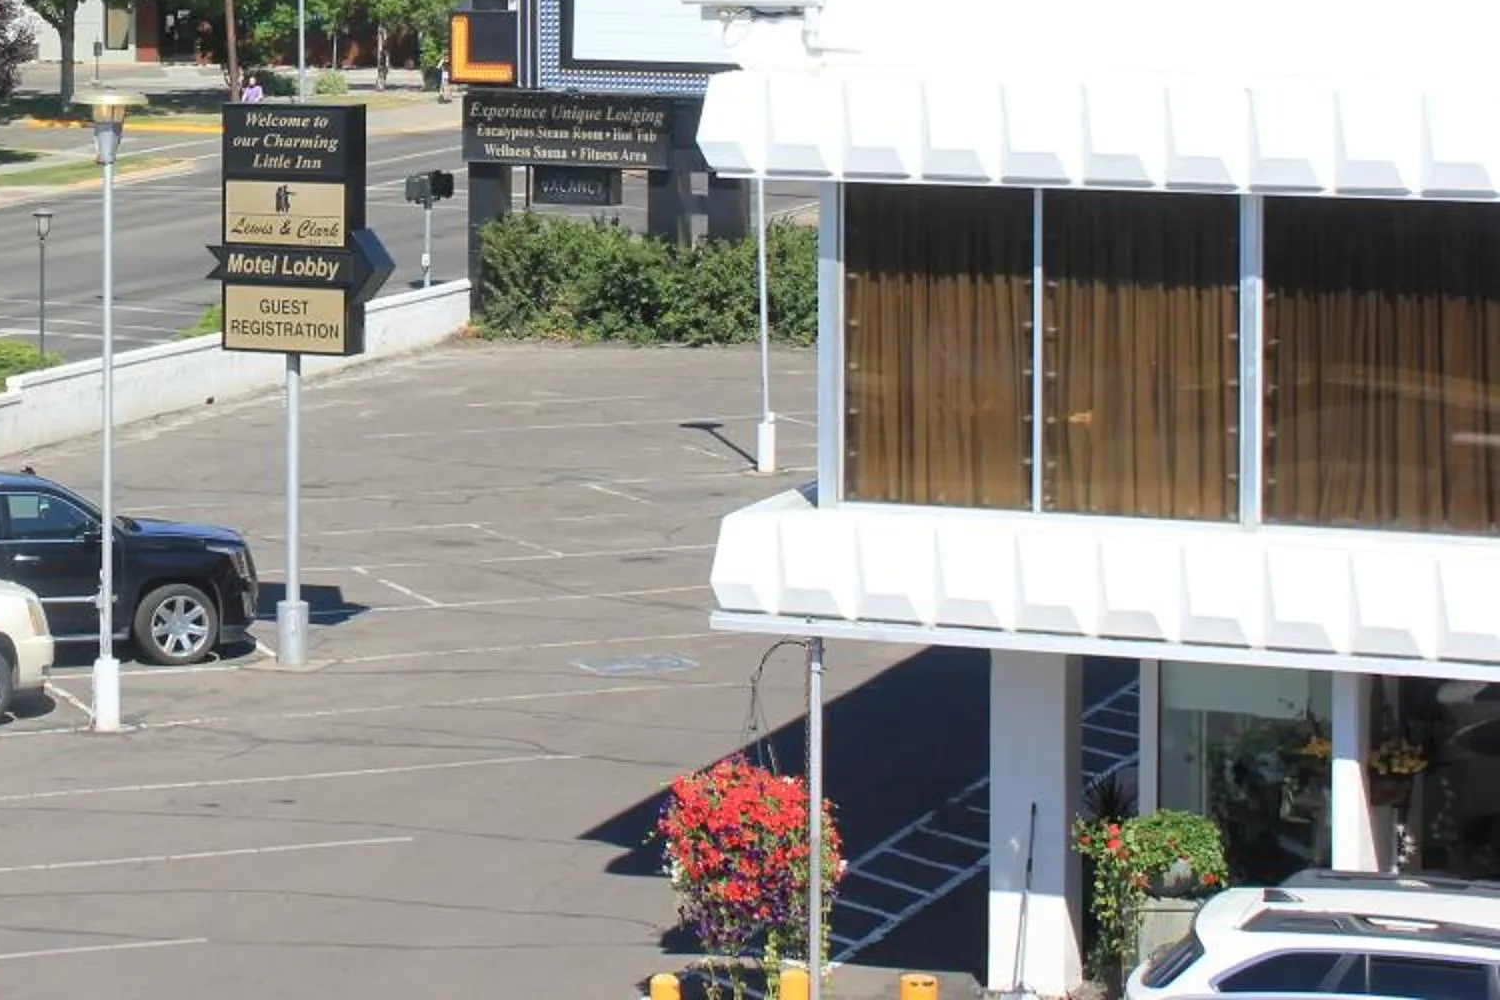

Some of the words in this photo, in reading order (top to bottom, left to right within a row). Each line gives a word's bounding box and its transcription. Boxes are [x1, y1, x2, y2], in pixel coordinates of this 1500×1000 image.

[245, 111, 310, 128] Welcome
[313, 114, 329, 128] to
[469, 102, 548, 120] Experience
[551, 104, 601, 124] Unique
[606, 107, 665, 127] Lodging
[476, 123, 534, 140] Eucalyptus
[537, 125, 570, 139] Steam
[572, 126, 604, 141] Room
[612, 127, 632, 141] Hot
[636, 128, 657, 142] Tub
[233, 136, 258, 147] our
[263, 135, 338, 151] Charming
[484, 143, 531, 158] Wellness
[533, 145, 567, 159] Sauna
[579, 146, 618, 161] Fitness
[620, 148, 648, 162] Area
[253, 153, 290, 169] Little
[296, 155, 322, 169] Inn
[231, 217, 273, 236] Lewis
[279, 220, 291, 235] &
[296, 219, 340, 239] Clark
[228, 253, 277, 275] Motel
[282, 255, 340, 281] Lobby
[259, 299, 309, 315] GUEST
[231, 320, 340, 339] REGISTRATION
